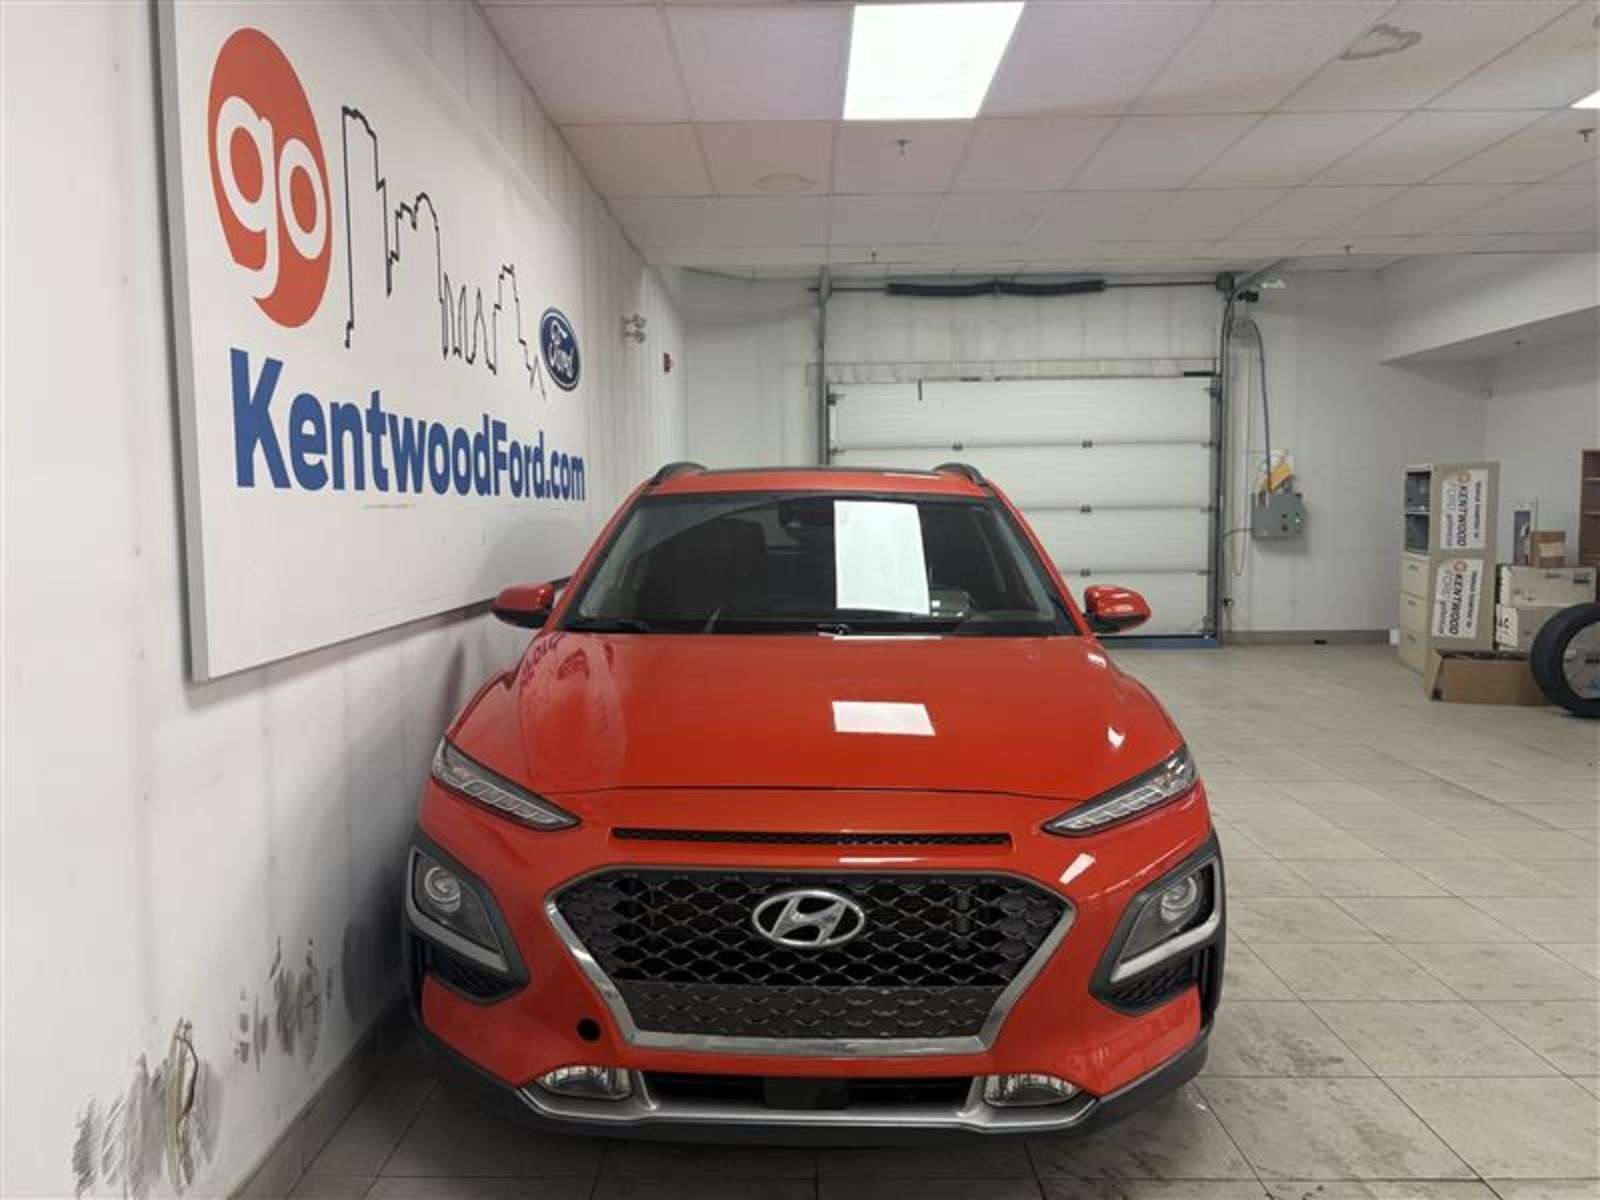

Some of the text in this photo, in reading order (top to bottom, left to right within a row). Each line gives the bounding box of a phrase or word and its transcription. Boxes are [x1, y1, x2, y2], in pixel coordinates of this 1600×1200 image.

[216, 95, 327, 300] go
[548, 318, 576, 380] Ford
[230, 347, 585, 501] KentwoodFord.com
[1457, 485, 1469, 547] KENTWOOD
[1449, 573, 1463, 635] KENTWOOD
